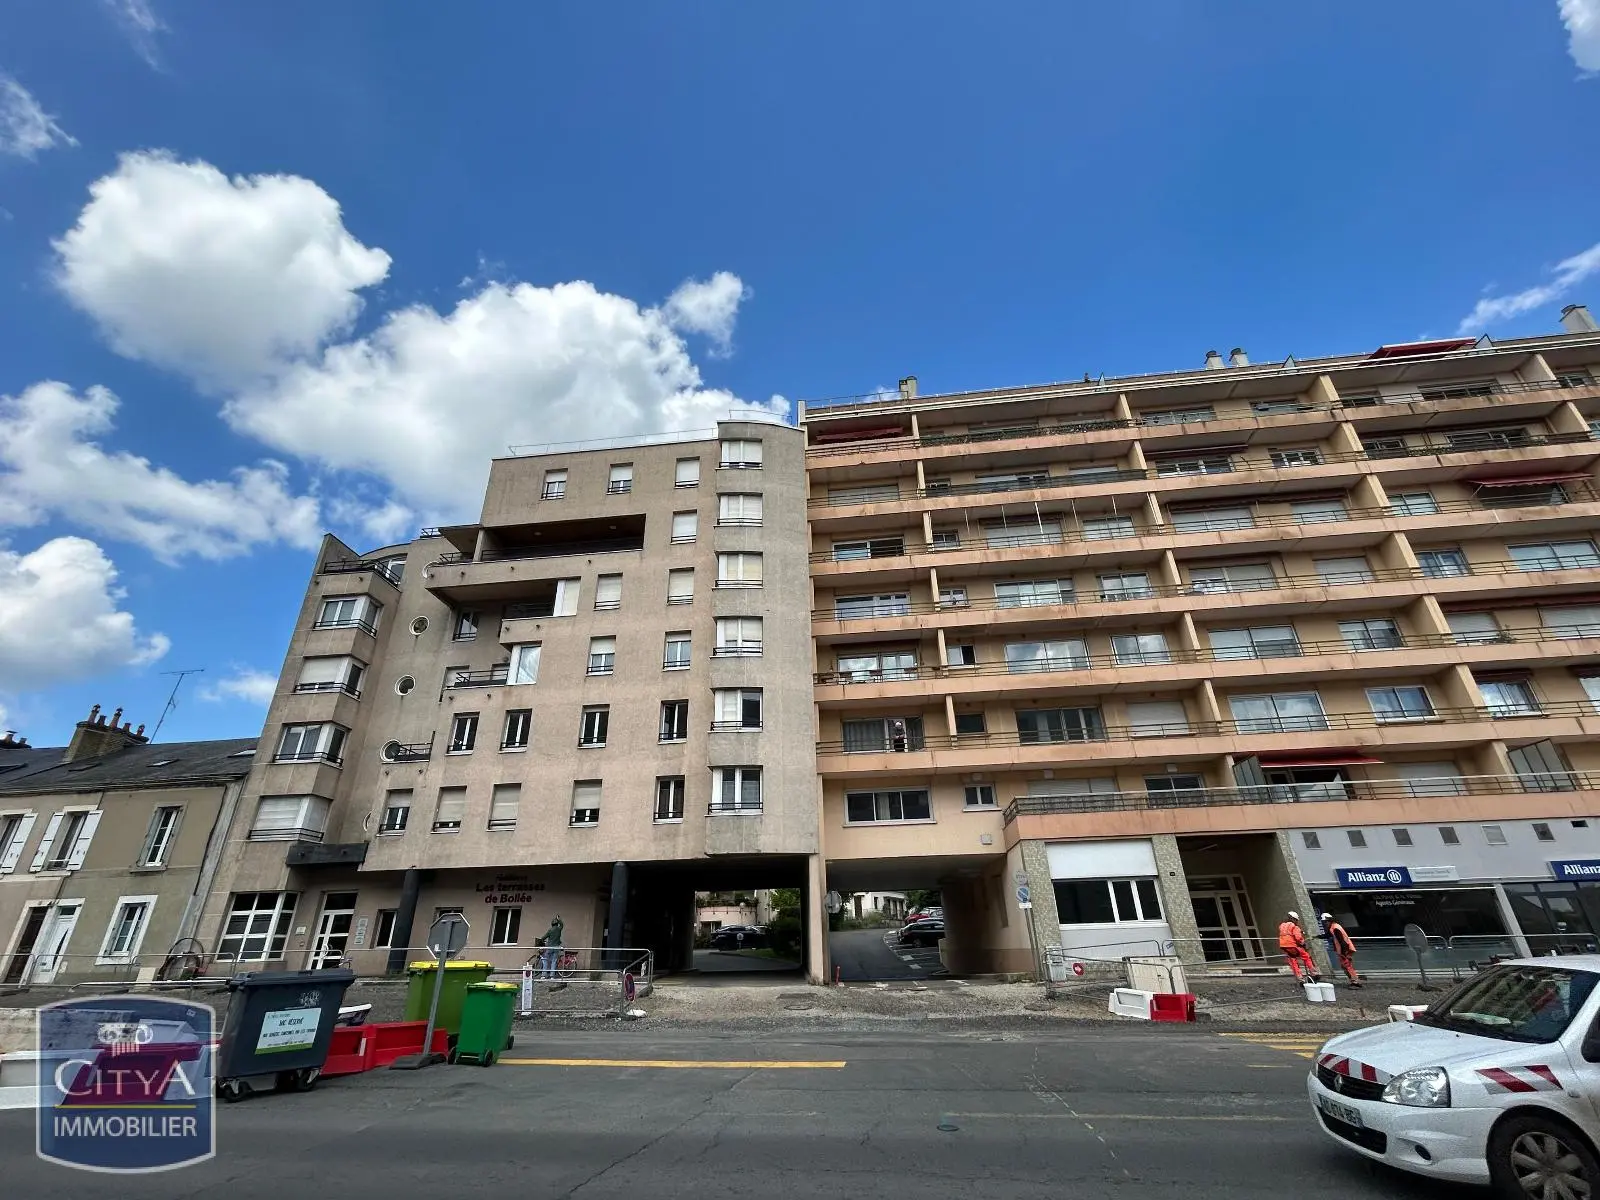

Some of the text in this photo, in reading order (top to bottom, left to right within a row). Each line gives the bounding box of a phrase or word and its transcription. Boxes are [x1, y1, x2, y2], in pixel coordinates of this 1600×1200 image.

[1563, 864, 1600, 875] Allianz
[1347, 872, 1387, 882] Allianz
[476, 883, 494, 892] Les
[484, 892, 532, 904] de Bollée
